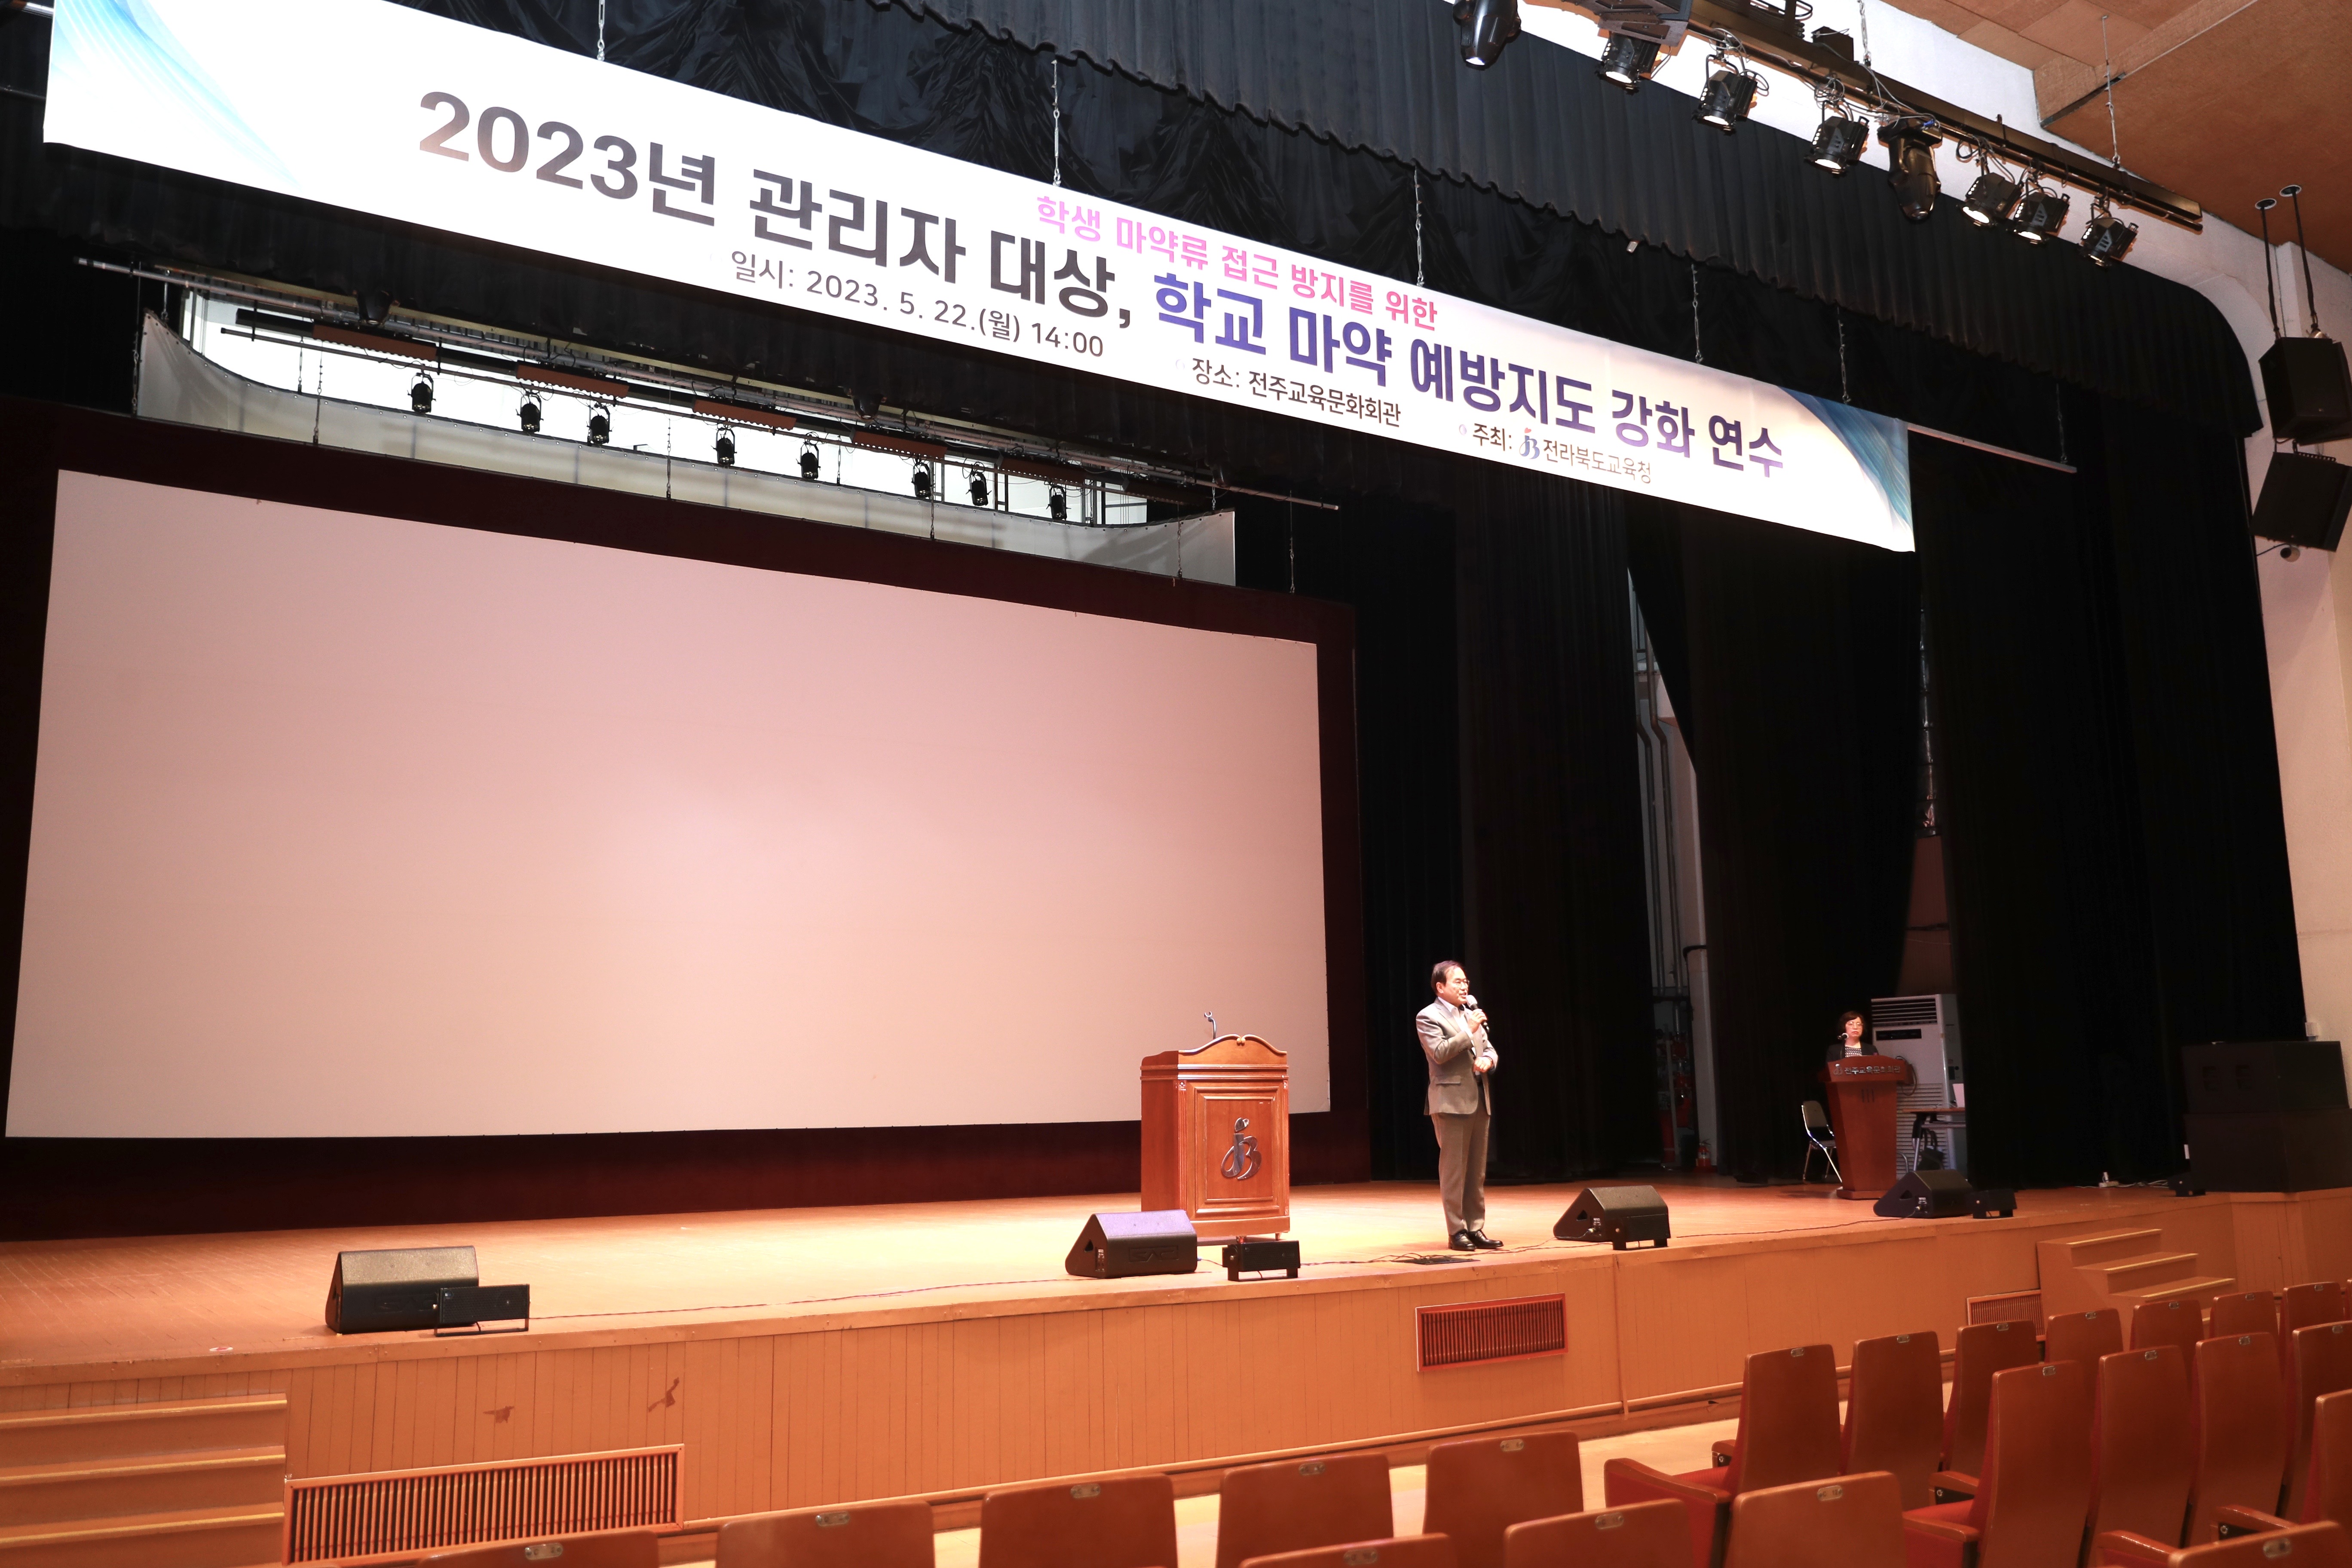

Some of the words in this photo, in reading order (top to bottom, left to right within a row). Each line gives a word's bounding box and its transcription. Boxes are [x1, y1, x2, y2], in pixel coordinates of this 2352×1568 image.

[420, 92, 715, 227] 2023년
[750, 169, 966, 284] 관리자
[990, 230, 1130, 329] 대상,
[1154, 273, 1266, 355] 학교
[1289, 307, 1392, 387] 마약
[1411, 338, 1595, 434] 예방지도
[1612, 389, 1695, 458] 강화
[1709, 415, 1783, 478] 연수
[732, 251, 793, 289] 일시:
[807, 271, 887, 310] 2023.
[900, 292, 922, 318] 5.
[934, 300, 1020, 342] 22.(월)
[1032, 323, 1102, 357] 14:00
[1037, 196, 1100, 241] 학생
[1117, 217, 1208, 270] 마약류
[1222, 246, 1278, 289] 접근
[1292, 264, 1373, 315] 방지를
[1386, 291, 1437, 331] 위한
[1192, 358, 1239, 388] 장소:
[1249, 371, 1401, 427] 전주교육문화회관
[1473, 423, 1512, 451] 주최:
[1544, 440, 1651, 484] 전라북도교육청
